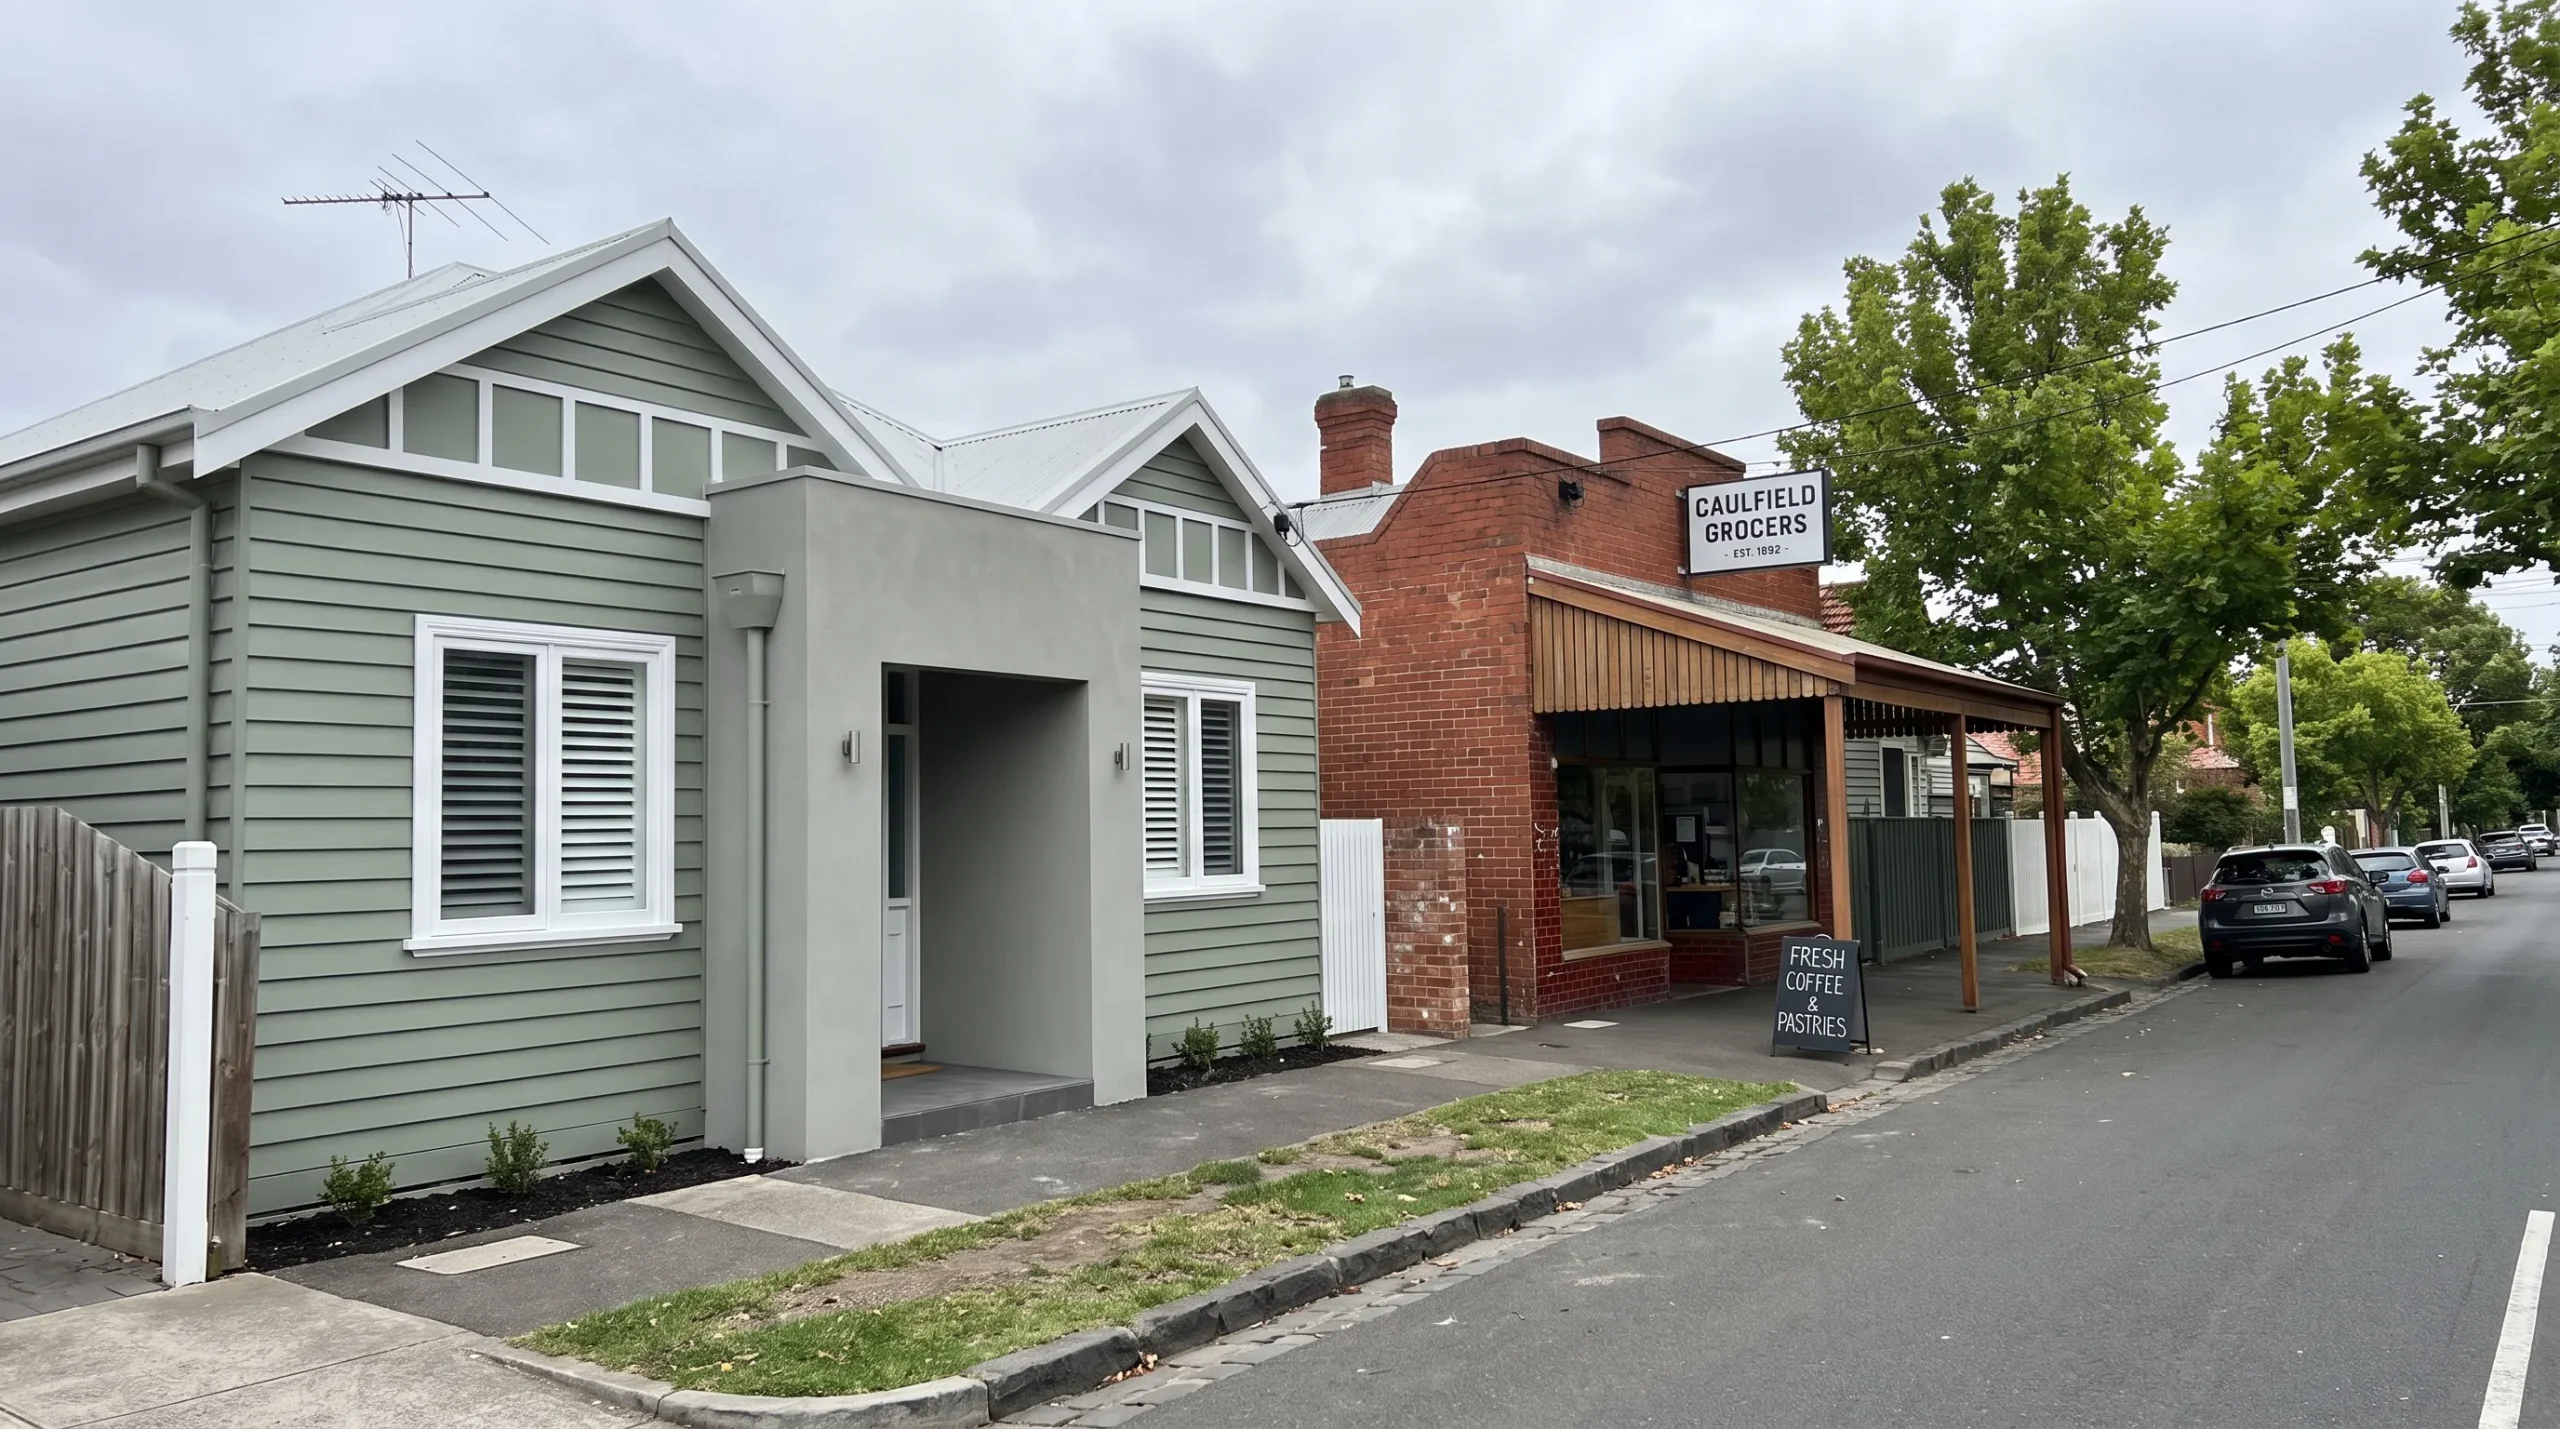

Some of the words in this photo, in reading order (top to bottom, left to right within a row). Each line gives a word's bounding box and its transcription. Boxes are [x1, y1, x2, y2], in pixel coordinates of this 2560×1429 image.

[1695, 484, 1816, 518] CAULFIELD
[1705, 513, 1808, 543] GROCERS
[1733, 547, 1754, 558] EST.
[1756, 545, 1781, 556] 1892
[1790, 945, 1846, 970] FRESH
[1785, 970, 1844, 995] COFFEE
[1807, 995, 1819, 1012] &
[1777, 1011, 1847, 1038] PASTRIES
